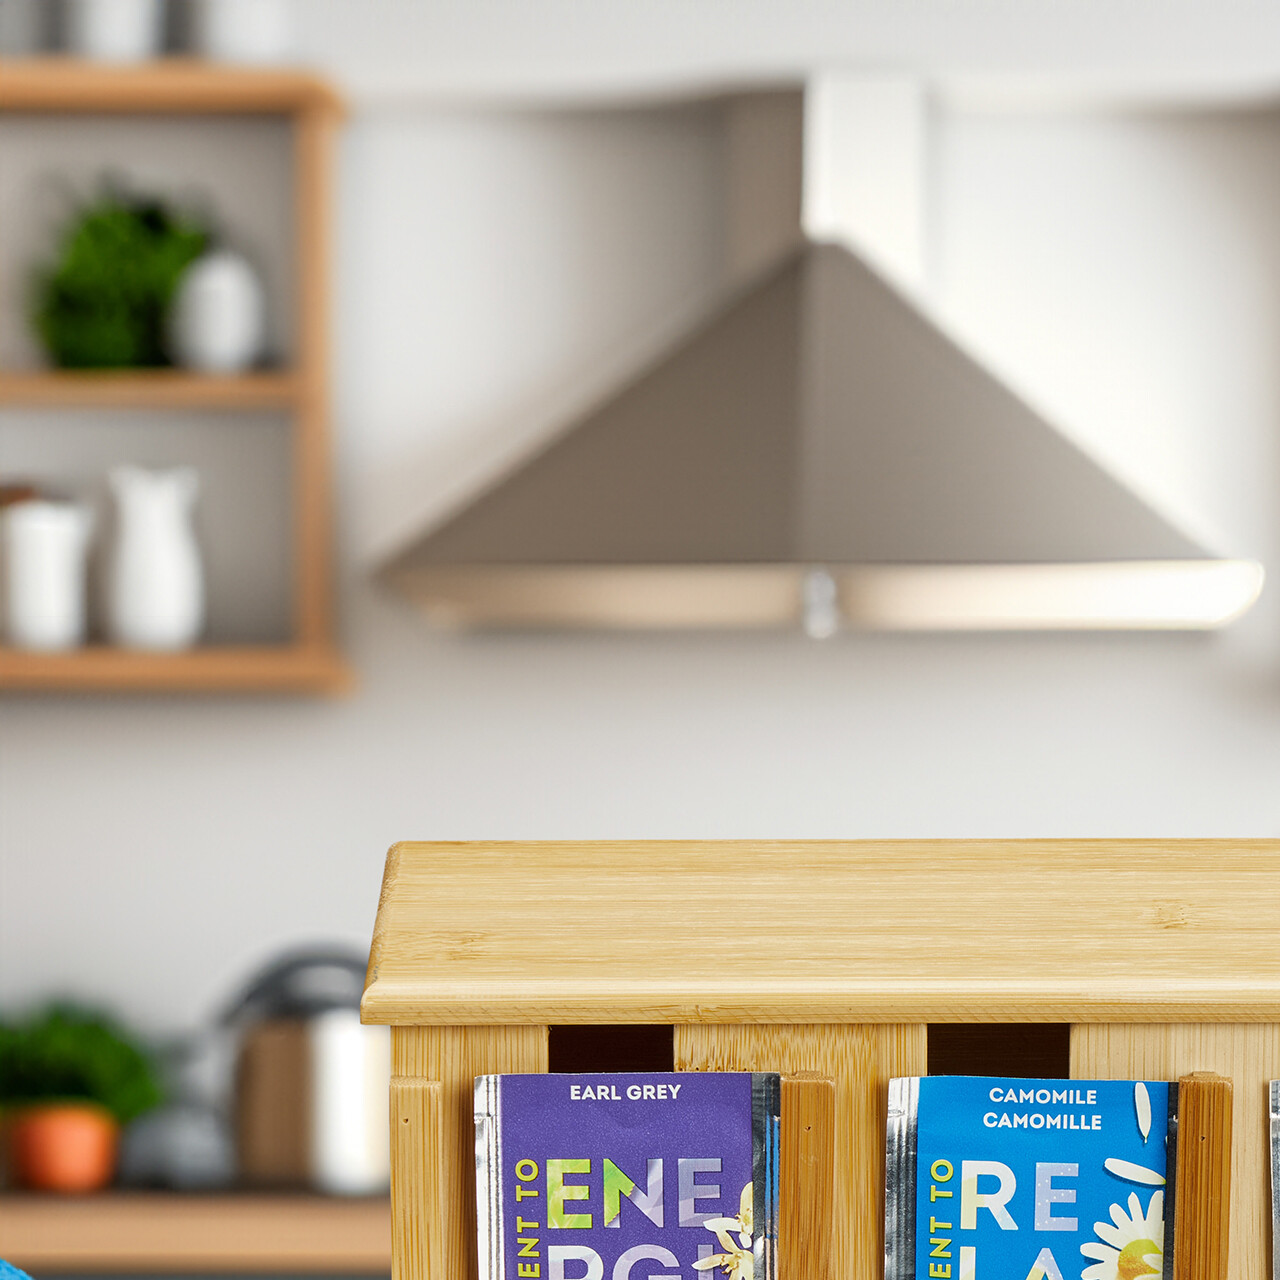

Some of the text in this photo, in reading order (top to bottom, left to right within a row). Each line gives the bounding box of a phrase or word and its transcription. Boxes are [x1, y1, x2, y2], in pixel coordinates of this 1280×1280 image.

[570, 1084, 681, 1100] EARL GREY
[989, 1087, 1097, 1105] CAMOMILE
[983, 1112, 1102, 1130] CAMOMILLE
[515, 1159, 539, 1202] TO
[546, 1158, 723, 1229] ENE
[930, 1159, 954, 1202] TO
[960, 1160, 1079, 1231] RE
